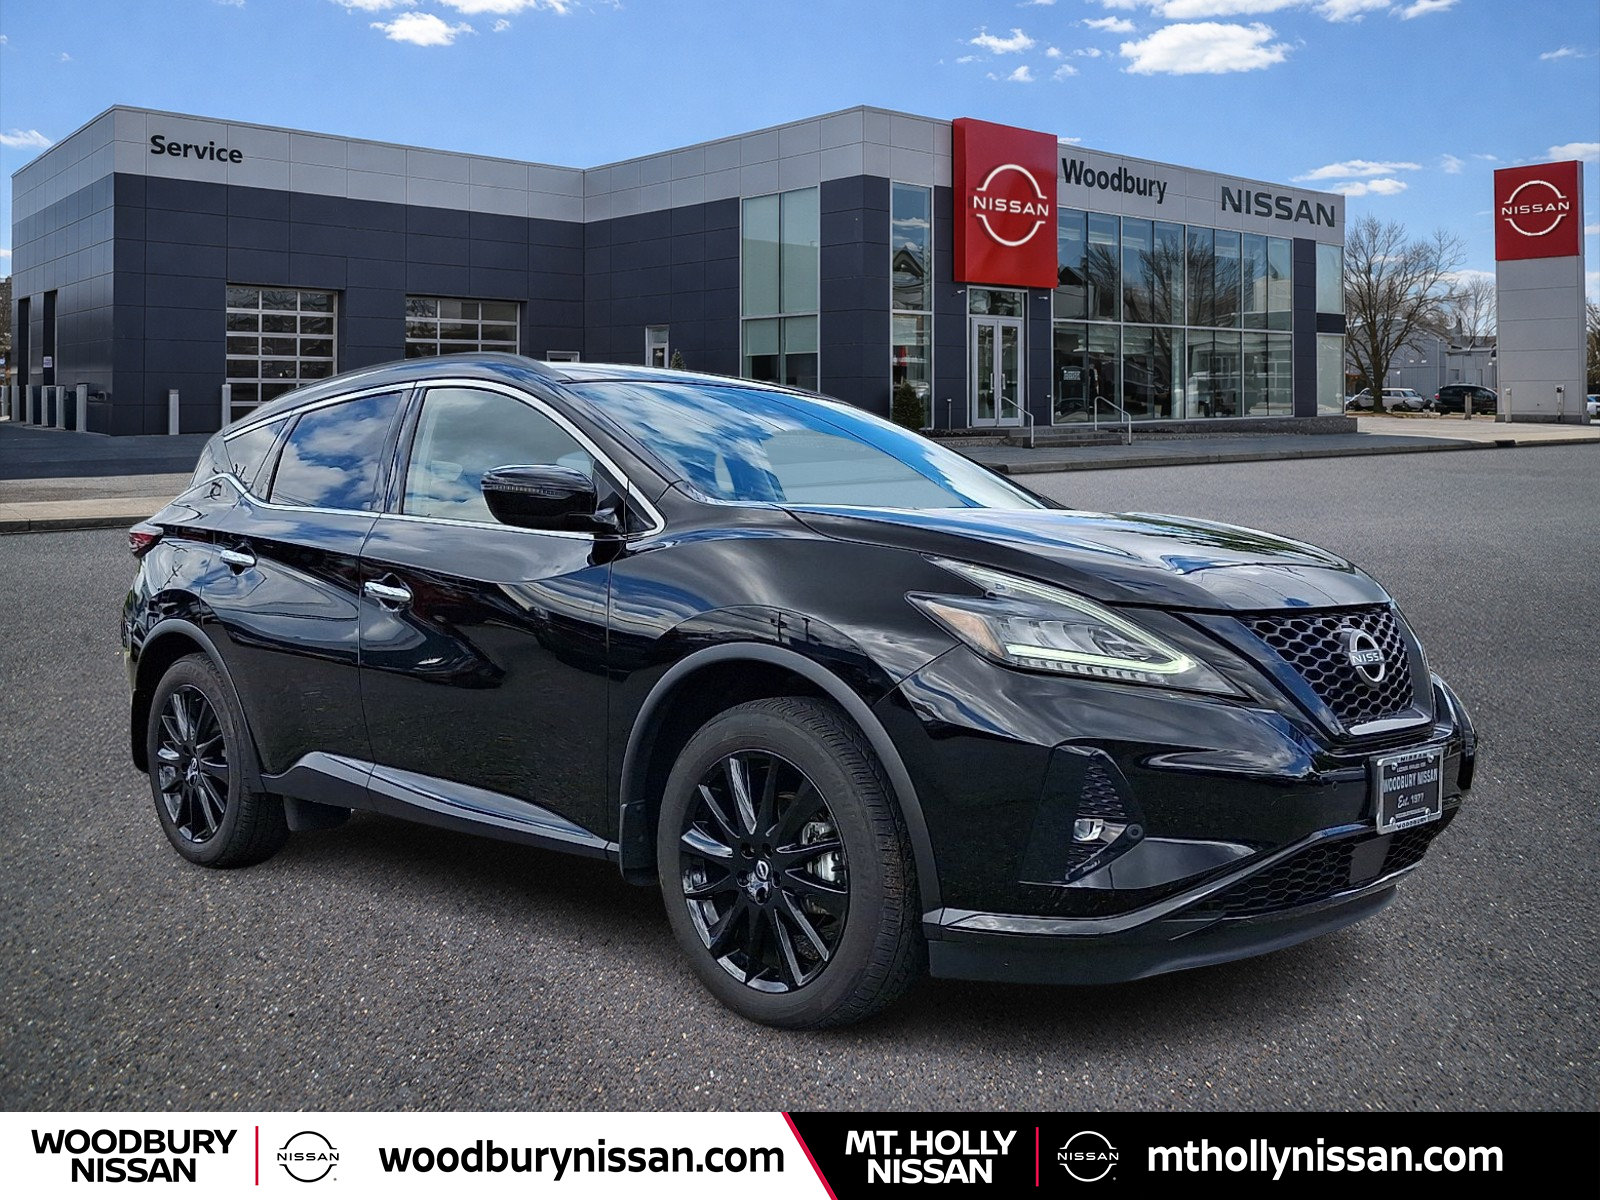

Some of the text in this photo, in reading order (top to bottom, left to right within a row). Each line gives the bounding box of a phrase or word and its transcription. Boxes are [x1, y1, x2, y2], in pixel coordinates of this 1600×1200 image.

[150, 134, 243, 164] Service
[1061, 157, 1168, 205] Woodbury
[973, 195, 1049, 217] NISSAN
[1221, 186, 1336, 228] NISSAN
[1501, 201, 1570, 216] NISSAN
[1351, 652, 1384, 664] NISS
[1383, 773, 1416, 793] WOODBURY
